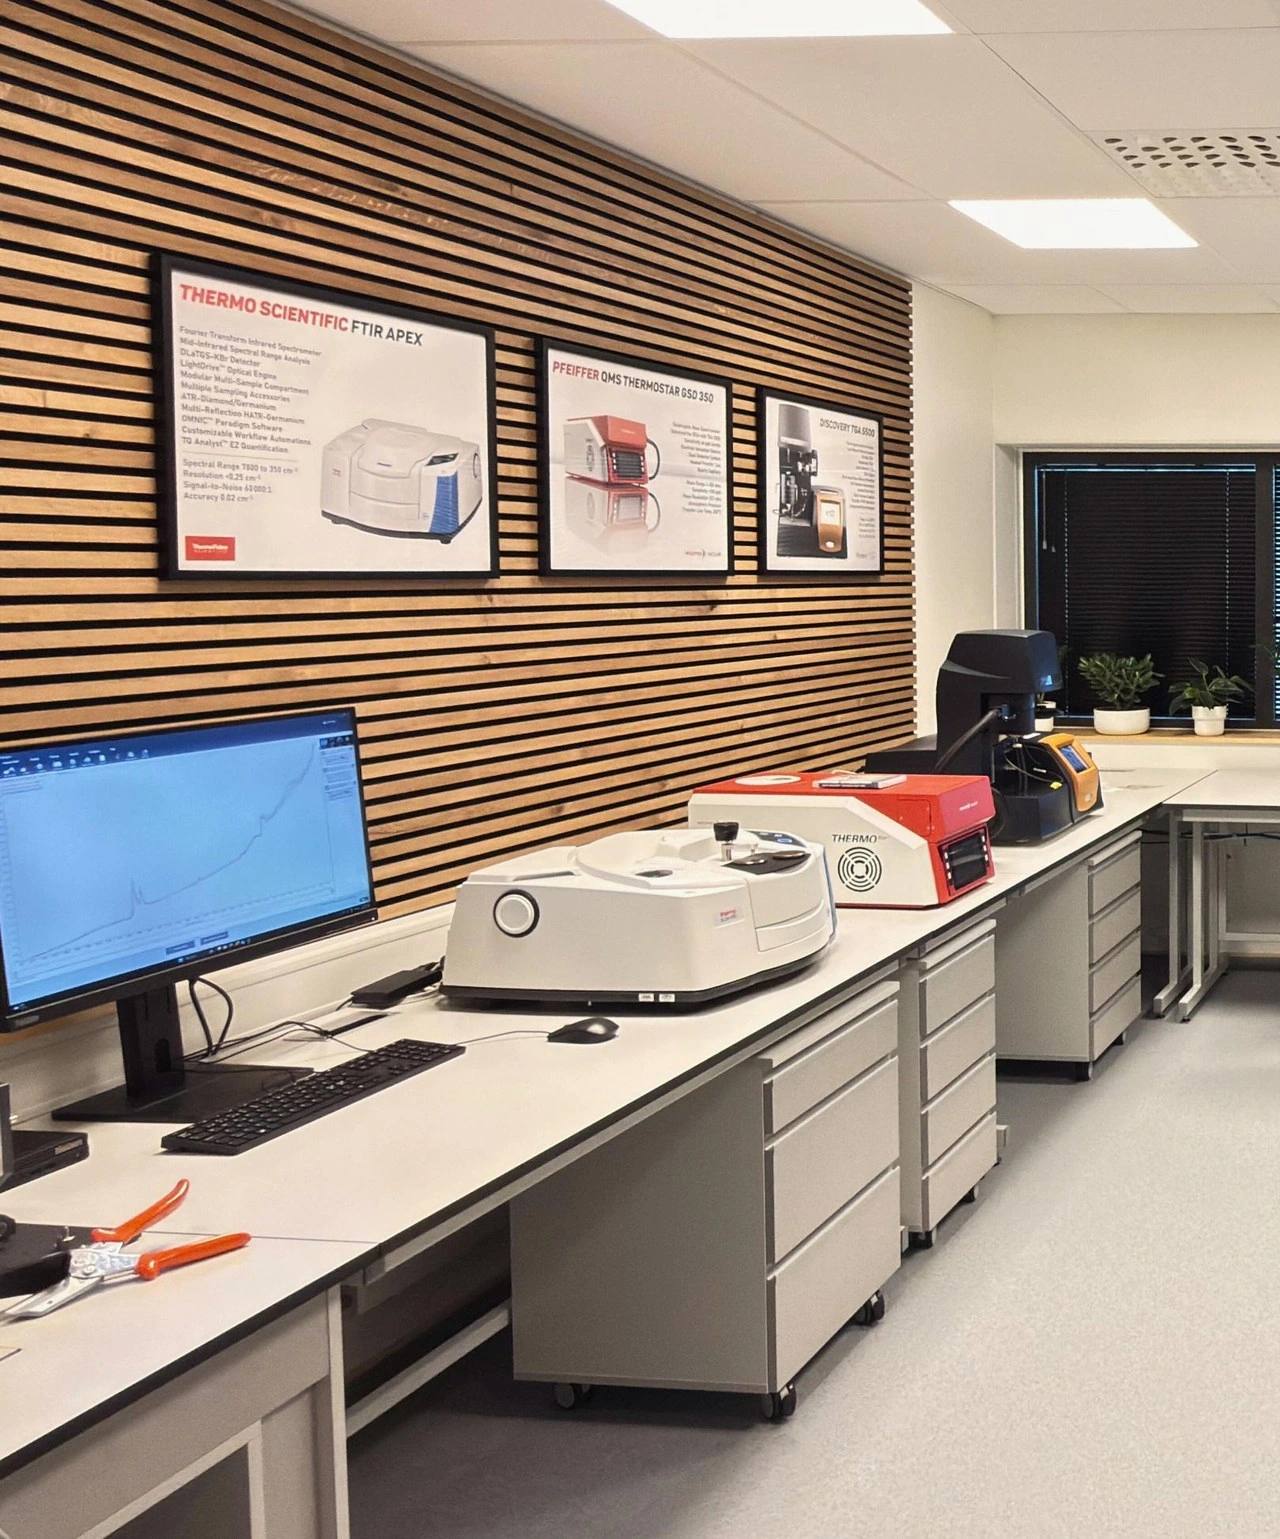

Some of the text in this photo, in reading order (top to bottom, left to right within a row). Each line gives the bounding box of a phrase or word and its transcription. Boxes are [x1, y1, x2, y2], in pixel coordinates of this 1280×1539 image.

[180, 284, 424, 347] THERMO SCIENTIFIC FTIR APEX
[210, 331, 247, 344] Transform
[248, 338, 276, 349] Infrared
[278, 343, 322, 357] Spectrometer
[180, 338, 310, 365] Mid-Infrared Spectral Range Analysis
[230, 356, 261, 367] Detector
[228, 366, 252, 377] Optical
[254, 369, 277, 380] Engine
[181, 371, 309, 394] Modular Multi-Sample Compartment
[552, 361, 714, 403] PFEIFFER QMS THERMOSTAR GSD 350
[181, 382, 290, 402] Multiple Sampling Accessories
[182, 404, 242, 418] Multi-Reflection
[216, 418, 250, 430] Paradigm
[252, 422, 283, 432] Software
[820, 418, 850, 432] DISCOVERY
[852, 424, 861, 434] TGA
[234, 431, 268, 441] Workflow
[270, 435, 311, 446] Automations
[183, 459, 215, 469] Spectral
[216, 462, 240, 472] Range
[183, 470, 224, 480] Resolution
[184, 481, 243, 492] Signal-to-Noise
[184, 492, 219, 503] Accuracy
